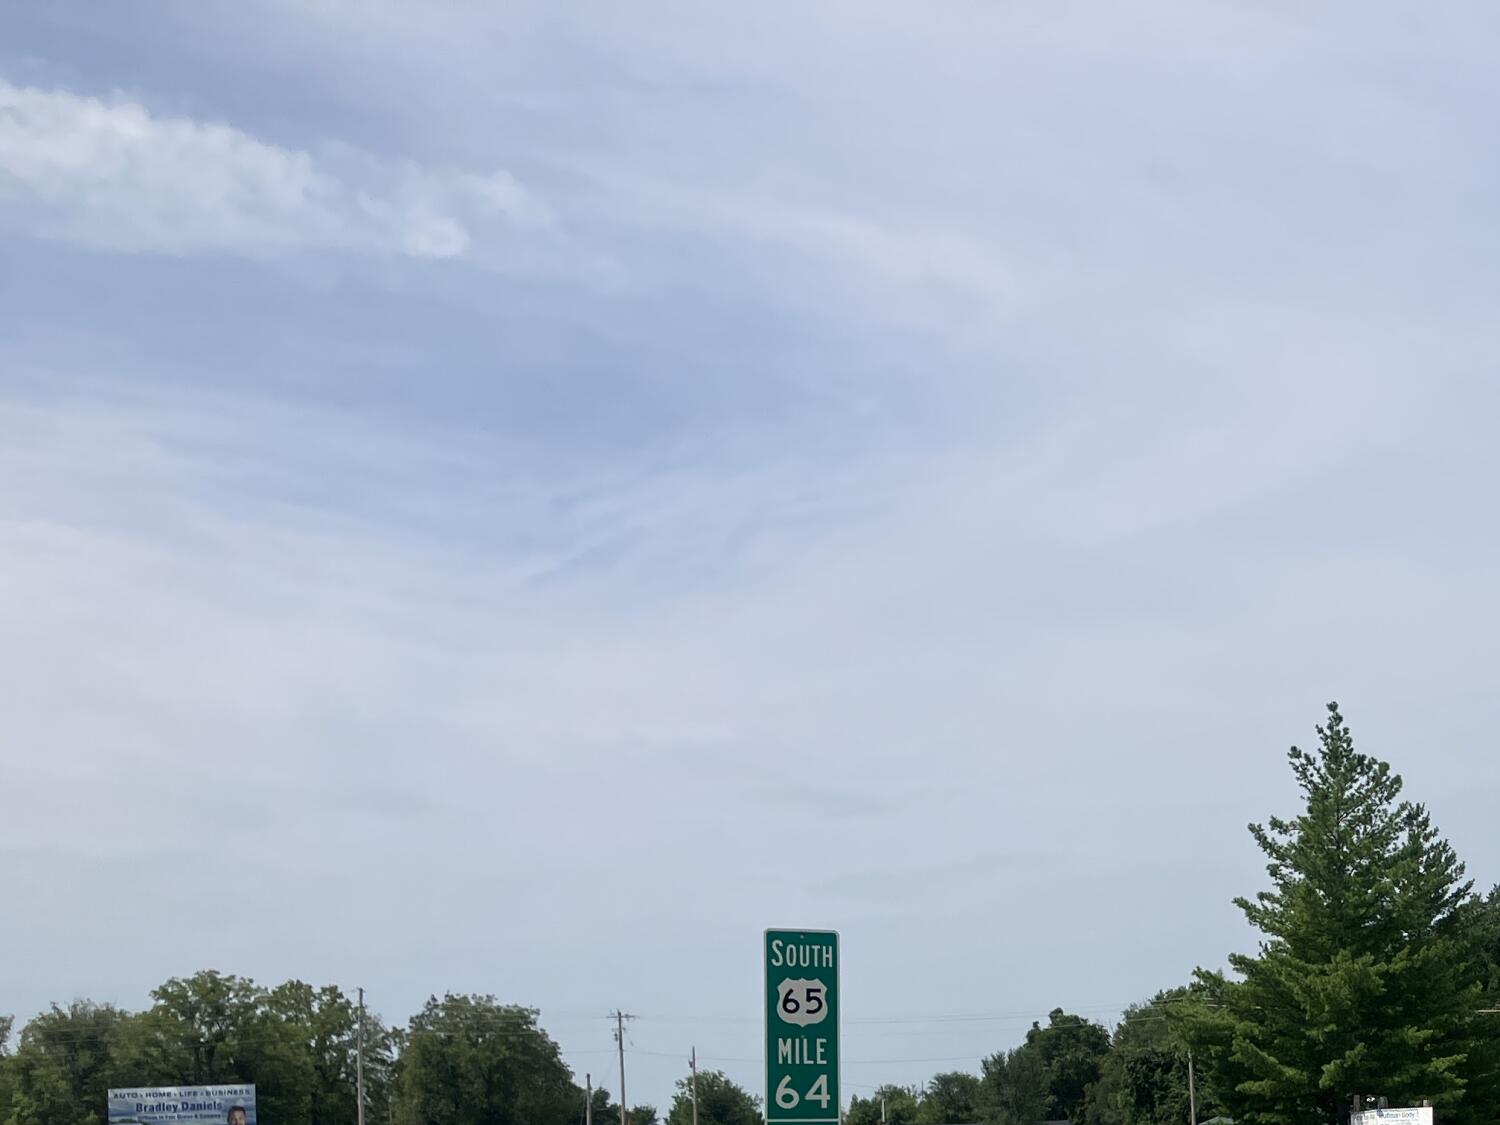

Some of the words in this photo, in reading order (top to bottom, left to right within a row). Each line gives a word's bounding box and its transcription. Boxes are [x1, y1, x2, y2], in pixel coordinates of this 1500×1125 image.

[771, 940, 833, 968] SOUTH
[782, 988, 823, 1014] 65
[778, 1038, 828, 1065] MILE
[205, 1088, 250, 1097] BUSINESS
[775, 1074, 831, 1110] 64
[136, 1102, 178, 1113] Bradley
[181, 1101, 223, 1111] Daniels
